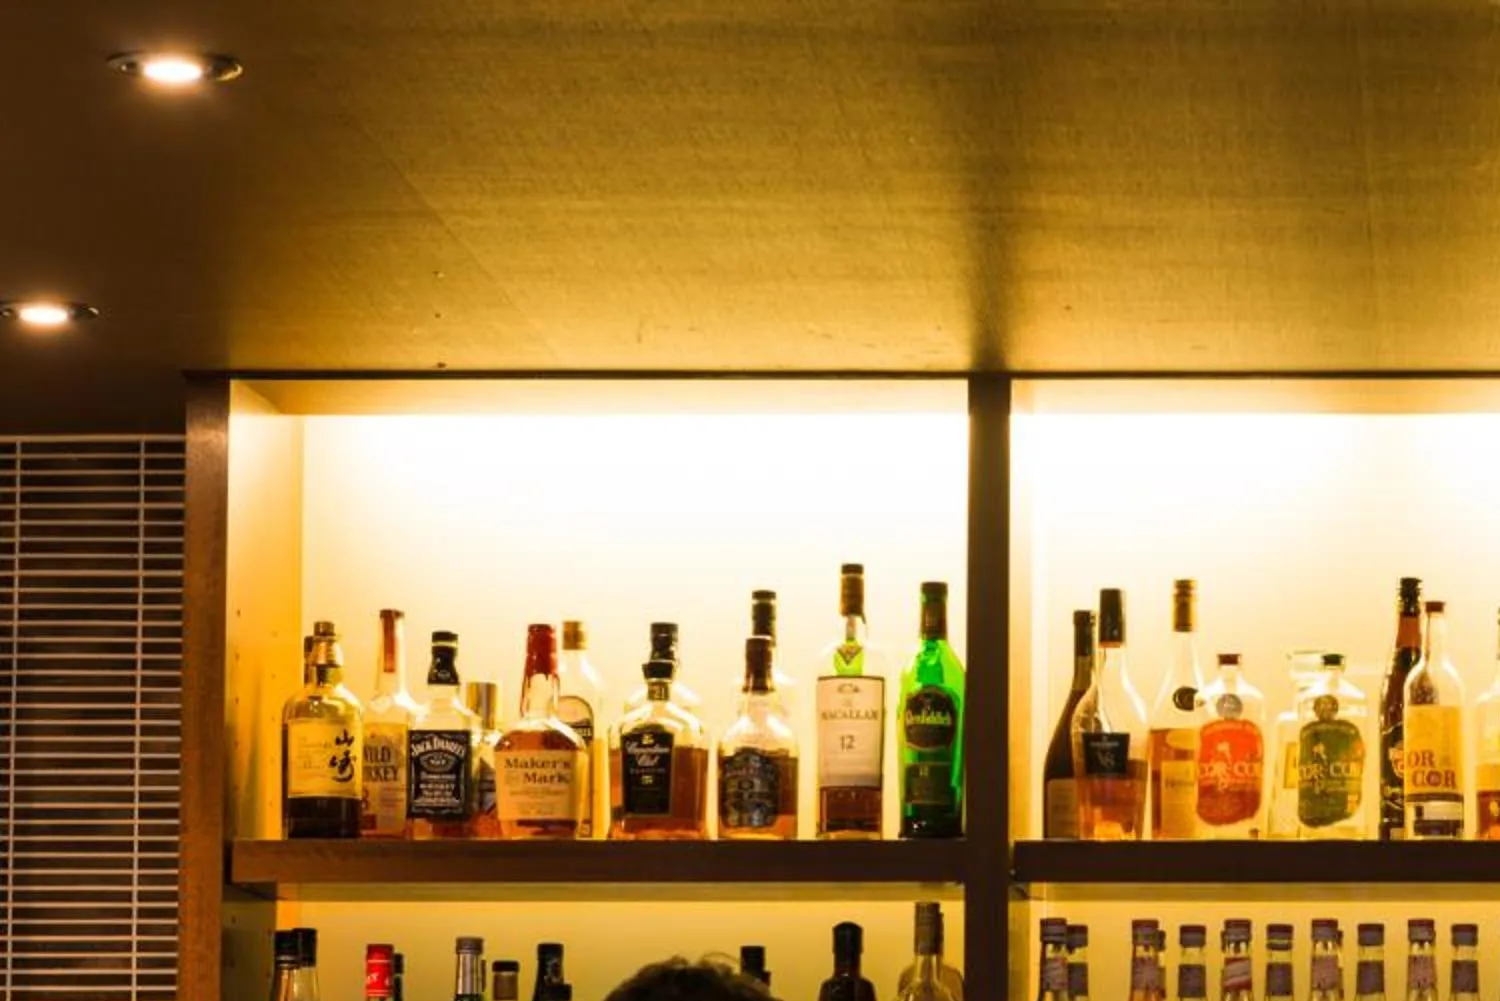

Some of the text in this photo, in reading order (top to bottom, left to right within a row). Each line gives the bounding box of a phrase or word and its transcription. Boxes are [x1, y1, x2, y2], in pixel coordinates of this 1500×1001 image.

[840, 734, 855, 751] 12
[329, 728, 357, 783] 山崎
[503, 757, 572, 770] Maker's
